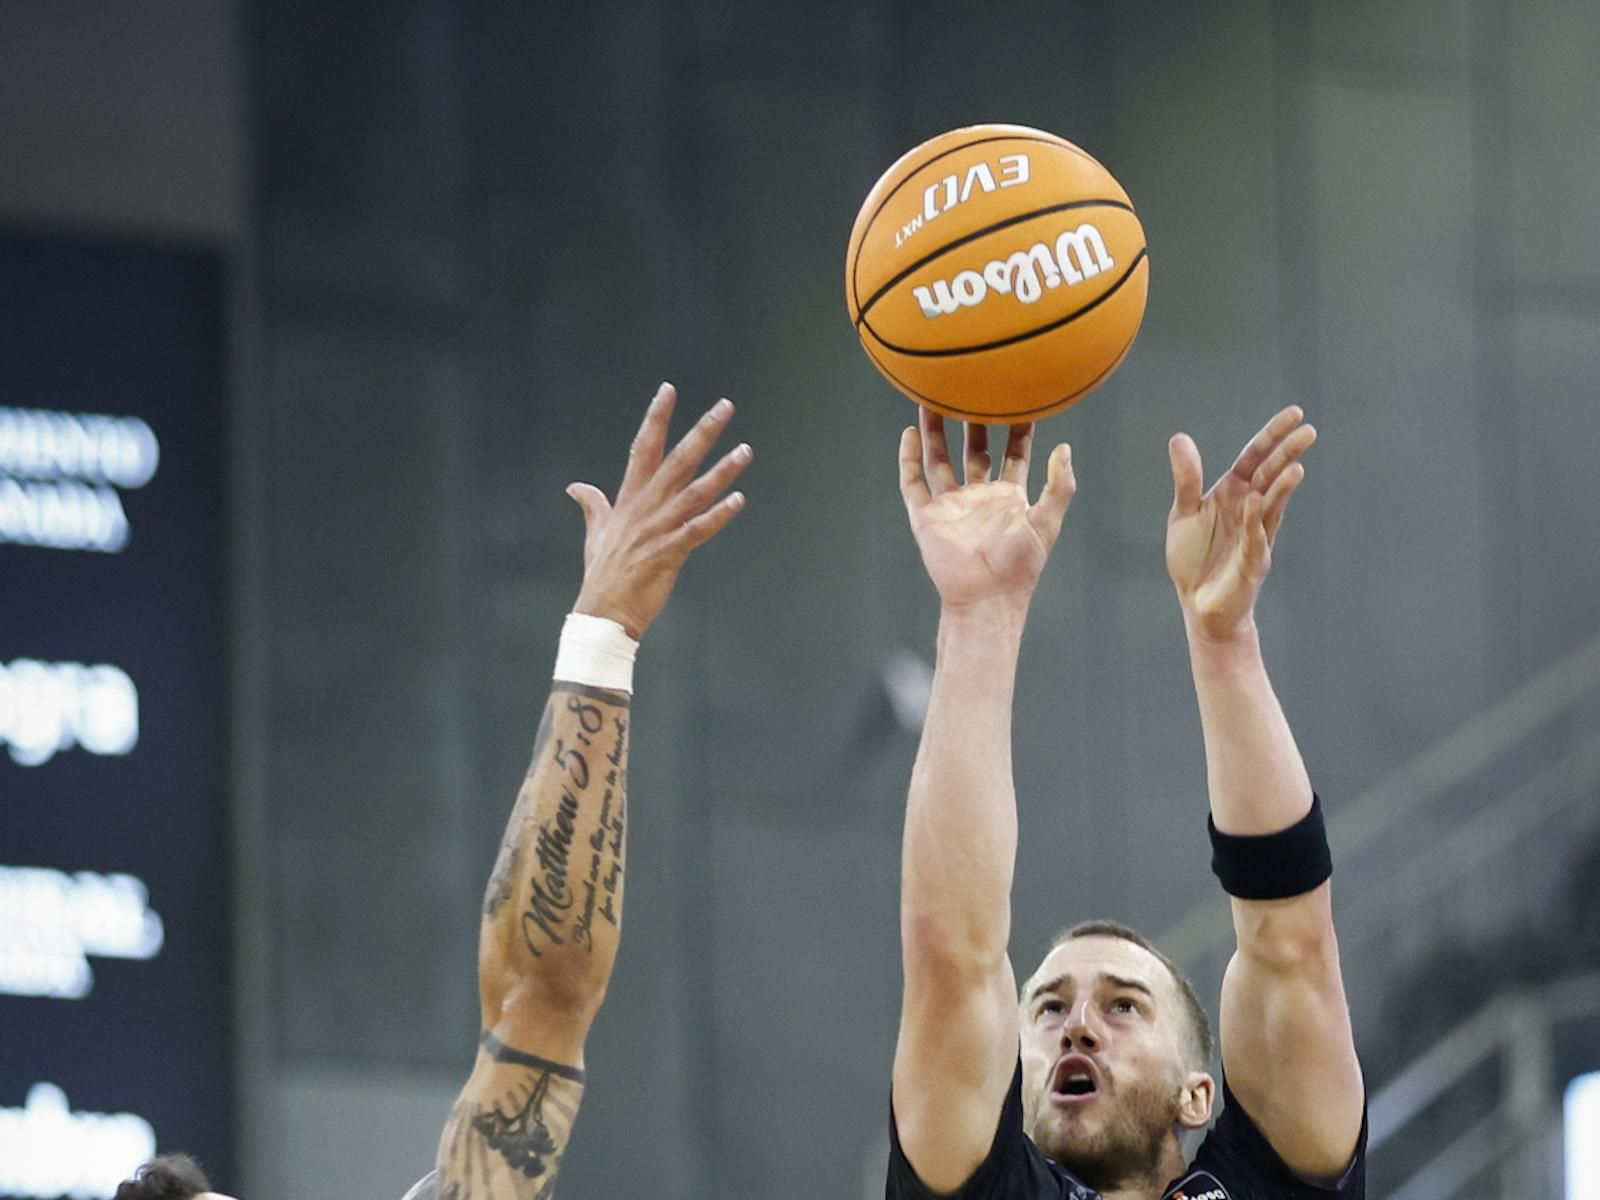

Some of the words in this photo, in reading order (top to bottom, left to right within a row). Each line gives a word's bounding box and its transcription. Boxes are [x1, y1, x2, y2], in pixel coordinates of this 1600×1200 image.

[894, 216, 924, 249] NXT
[912, 223, 1115, 321] Wilson
[521, 783, 580, 958] Matthew
